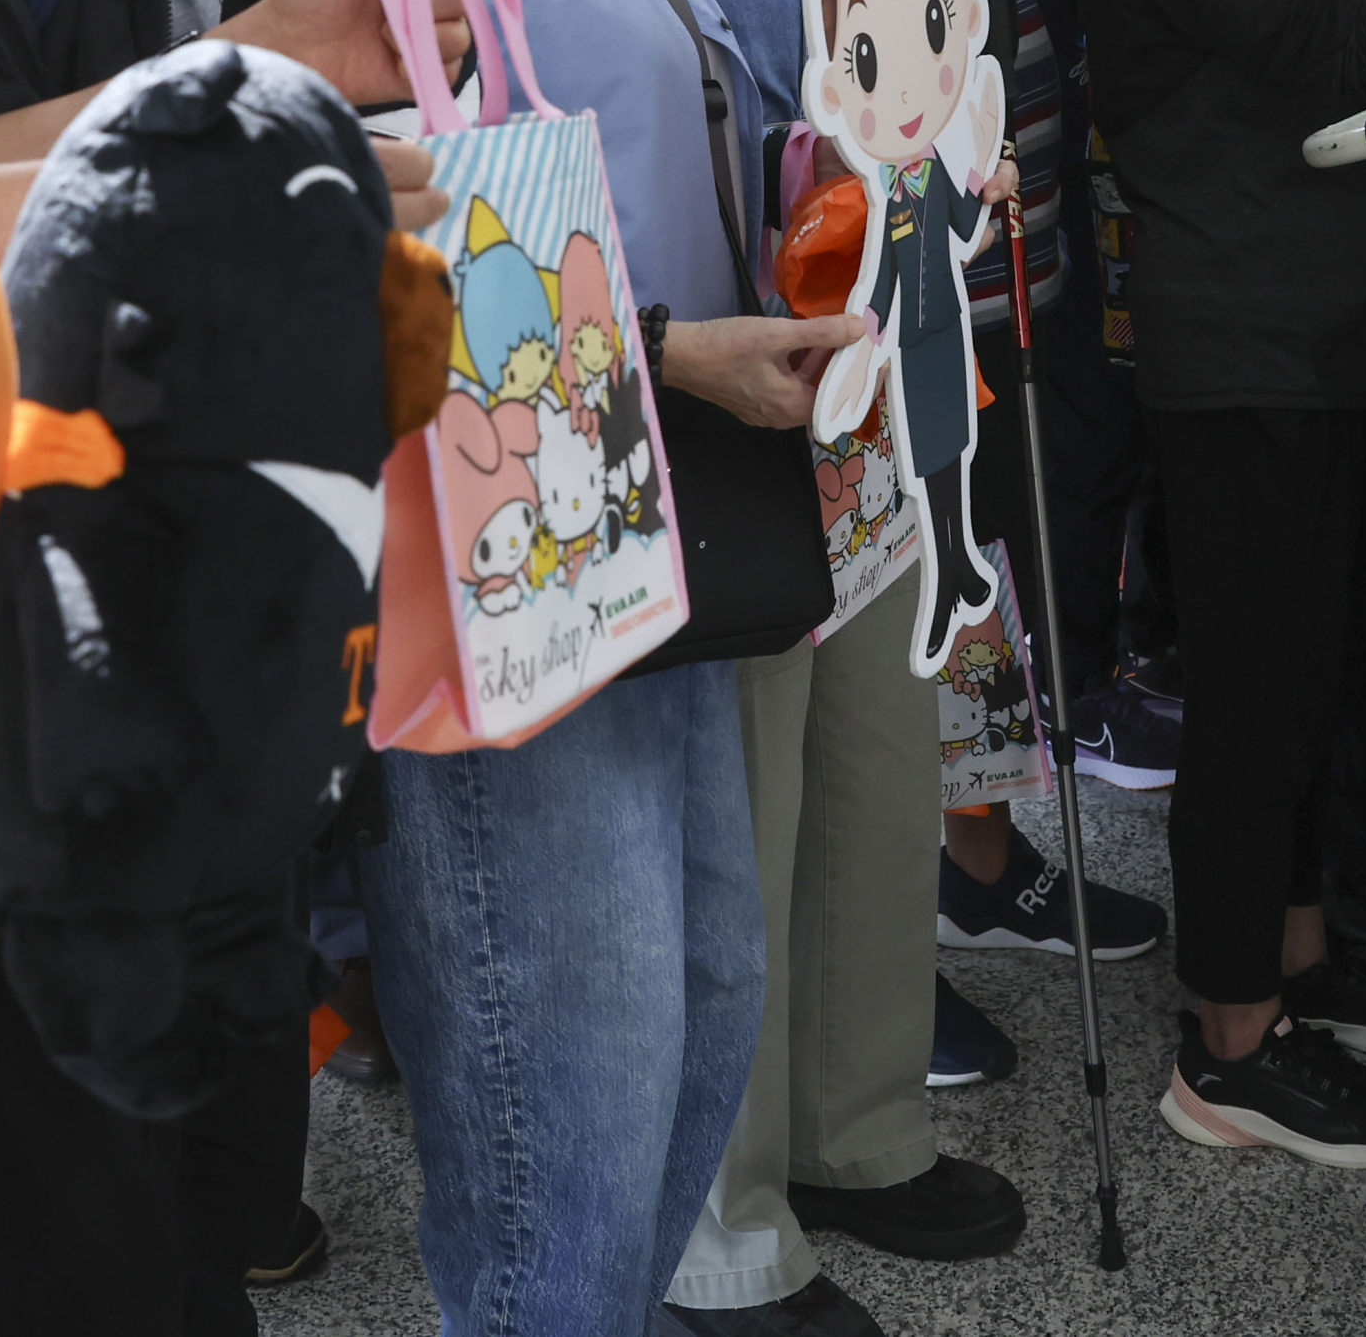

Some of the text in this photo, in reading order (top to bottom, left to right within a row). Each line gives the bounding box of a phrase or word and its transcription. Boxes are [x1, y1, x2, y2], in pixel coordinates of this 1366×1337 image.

[605, 595, 628, 619] EVA
[626, 585, 649, 610] AIR
[479, 618, 584, 706] sky shop
[986, 768, 1024, 782] EVA AIR
